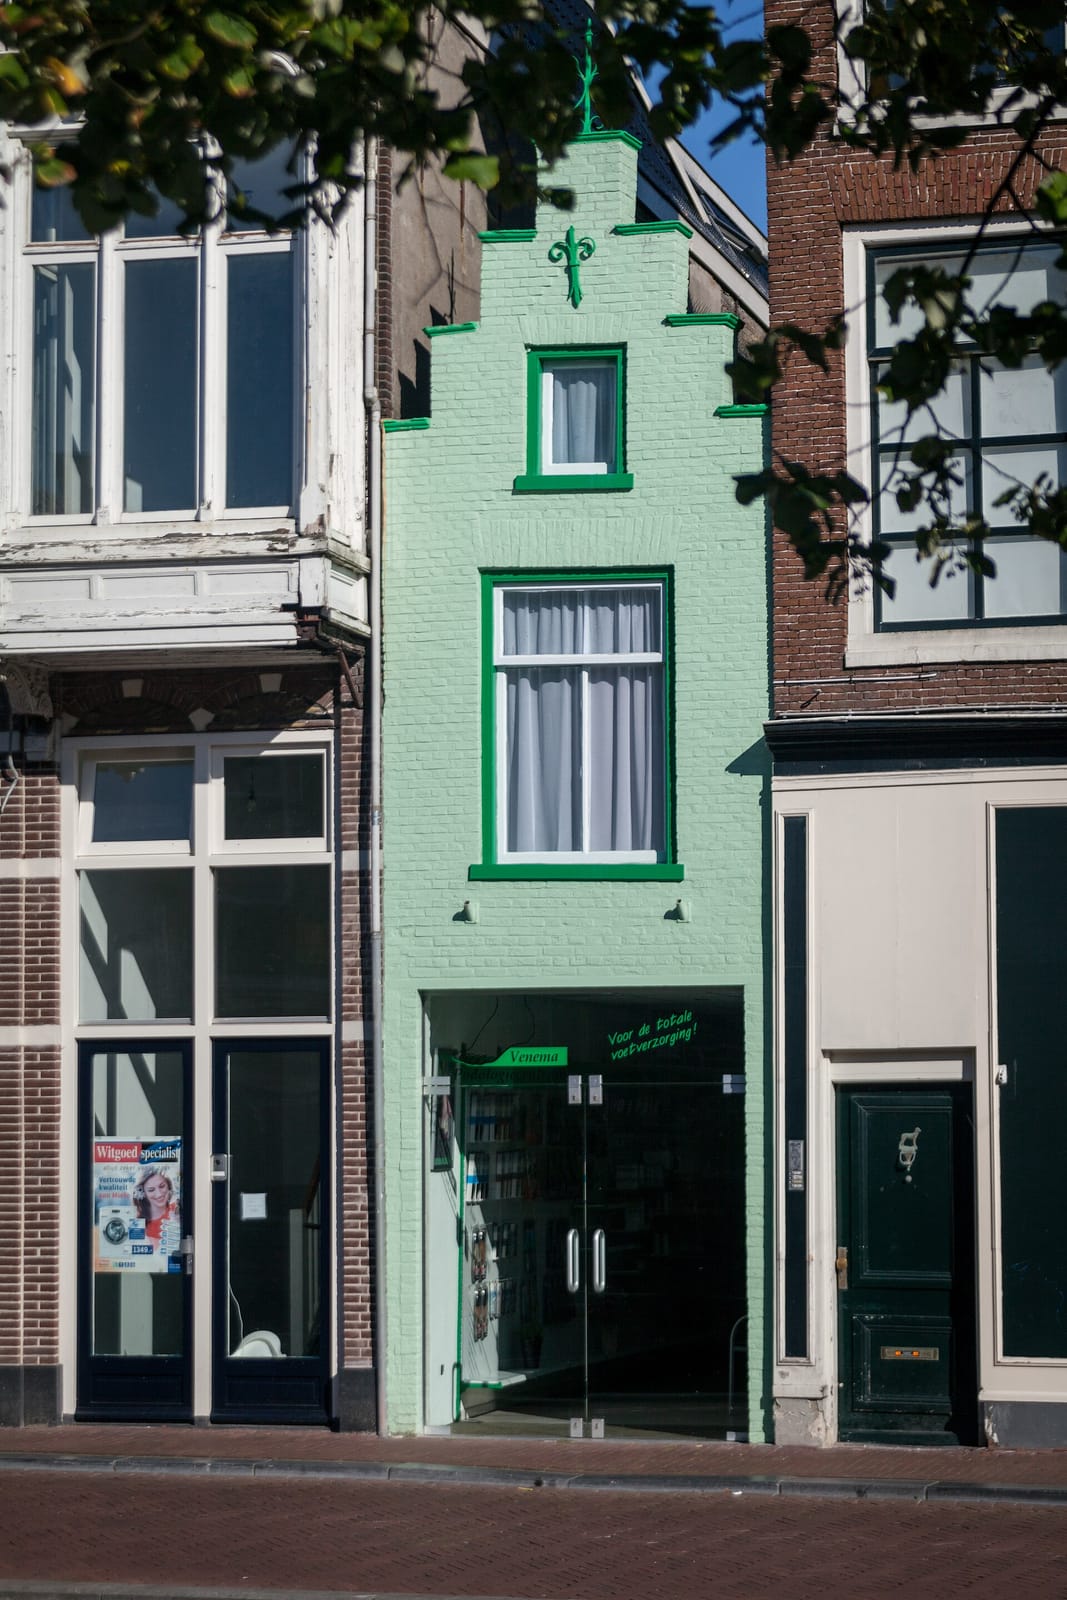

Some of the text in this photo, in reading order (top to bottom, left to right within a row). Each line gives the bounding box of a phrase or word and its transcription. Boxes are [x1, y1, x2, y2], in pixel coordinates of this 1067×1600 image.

[608, 1009, 693, 1046] Voor de totale
[611, 1022, 698, 1061] voetverzorging!
[510, 1050, 559, 1063] Venema
[96, 1145, 180, 1161] Witgoed specialist
